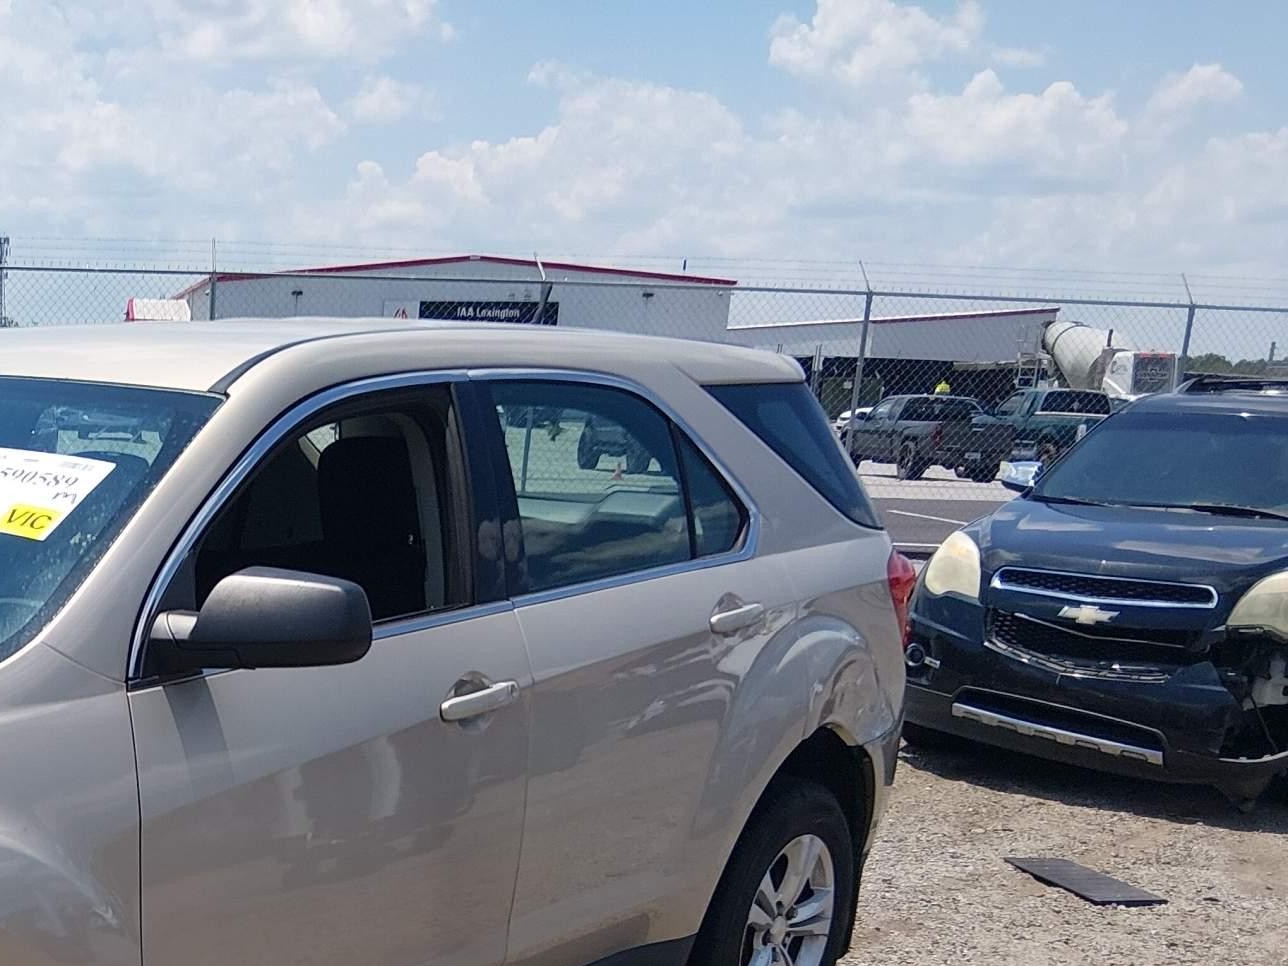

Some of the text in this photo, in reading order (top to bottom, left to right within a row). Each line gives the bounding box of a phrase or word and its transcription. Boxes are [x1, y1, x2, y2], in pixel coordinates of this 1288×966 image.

[456, 306, 520, 320] IAA Lexington
[6, 508, 53, 530] VIC
